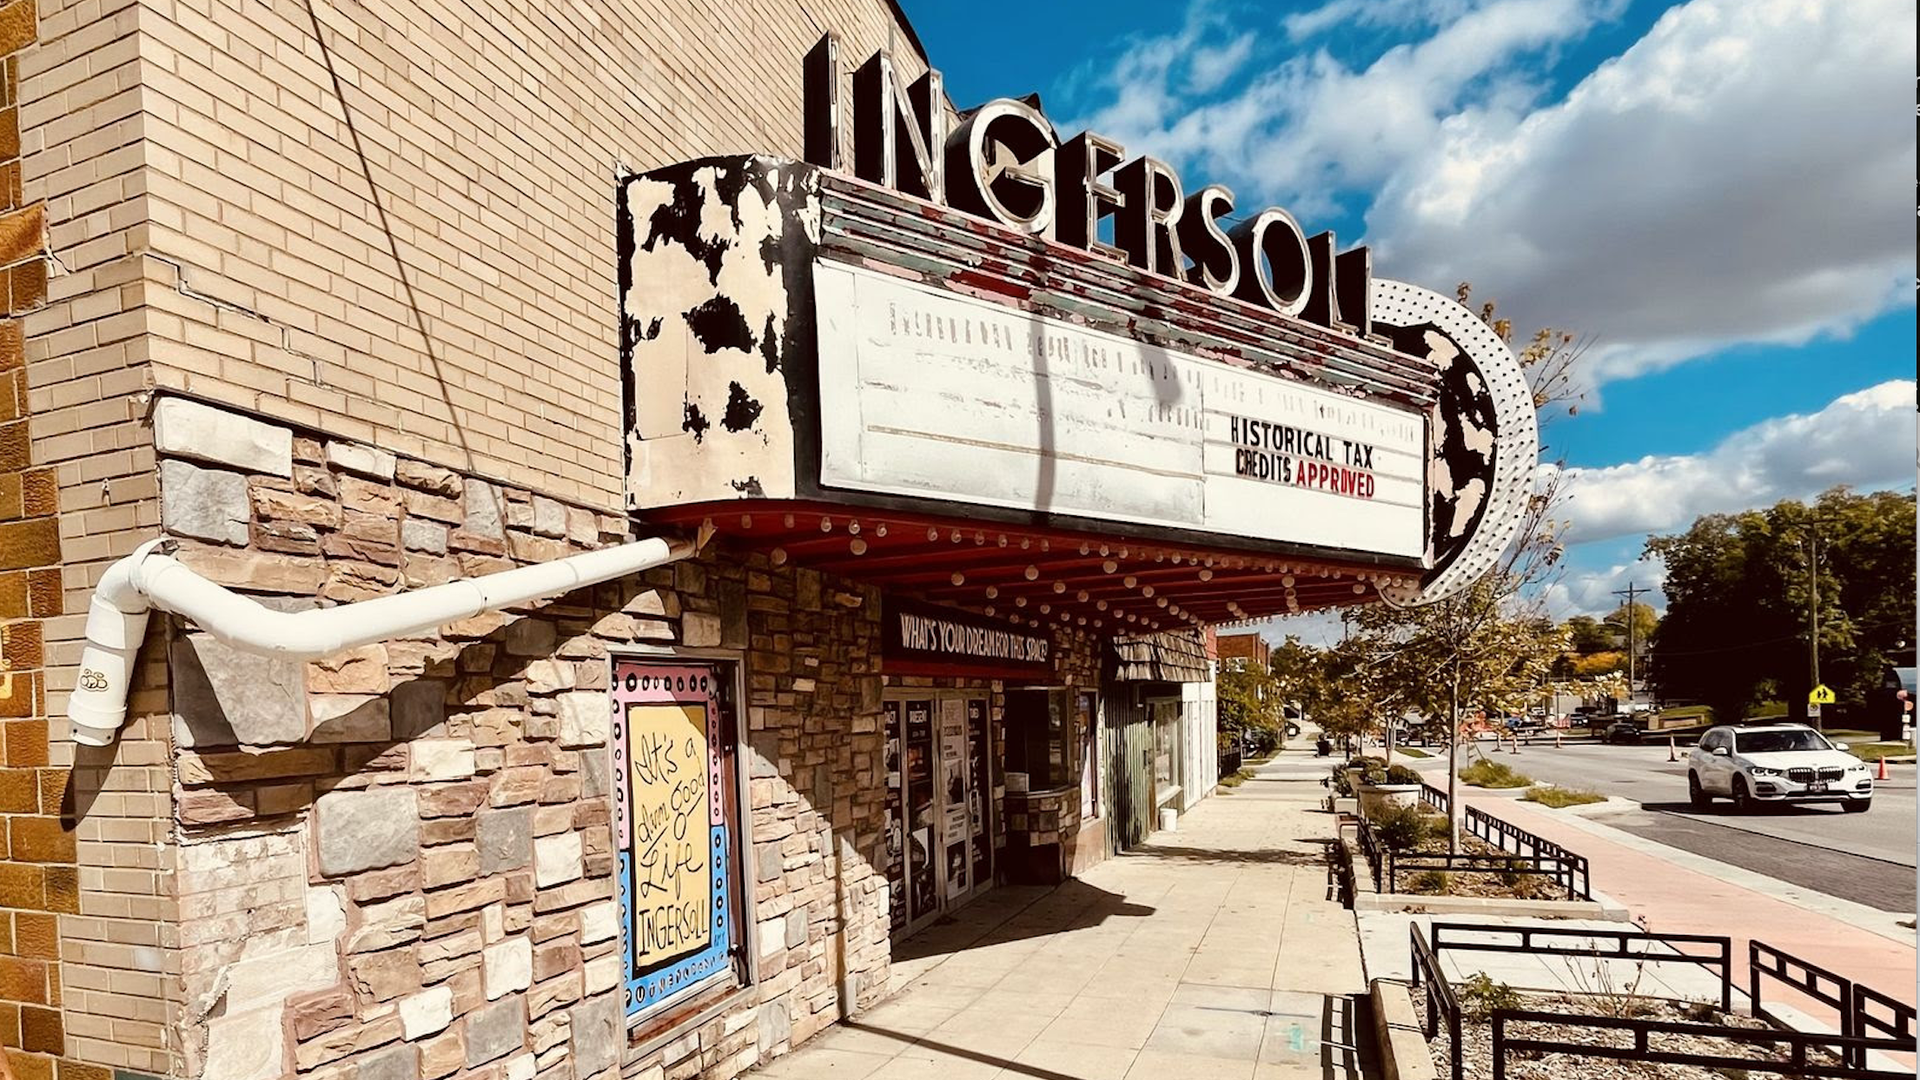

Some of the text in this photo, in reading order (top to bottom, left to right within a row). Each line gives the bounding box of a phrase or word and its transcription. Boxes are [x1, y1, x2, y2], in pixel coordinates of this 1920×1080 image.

[804, 28, 1394, 348] INGERSOLL
[1231, 416, 1374, 469] HISTORICAL TAX
[1236, 448, 1375, 498] CREDITS APPROVED
[899, 612, 937, 651] WHAT'S
[938, 619, 965, 654] YOUR
[966, 625, 995, 658] DREAM
[995, 630, 1009, 659] FOR
[1009, 633, 1025, 660] THIS
[634, 732, 697, 785] It's a
[638, 899, 708, 957] INGERSOLL
